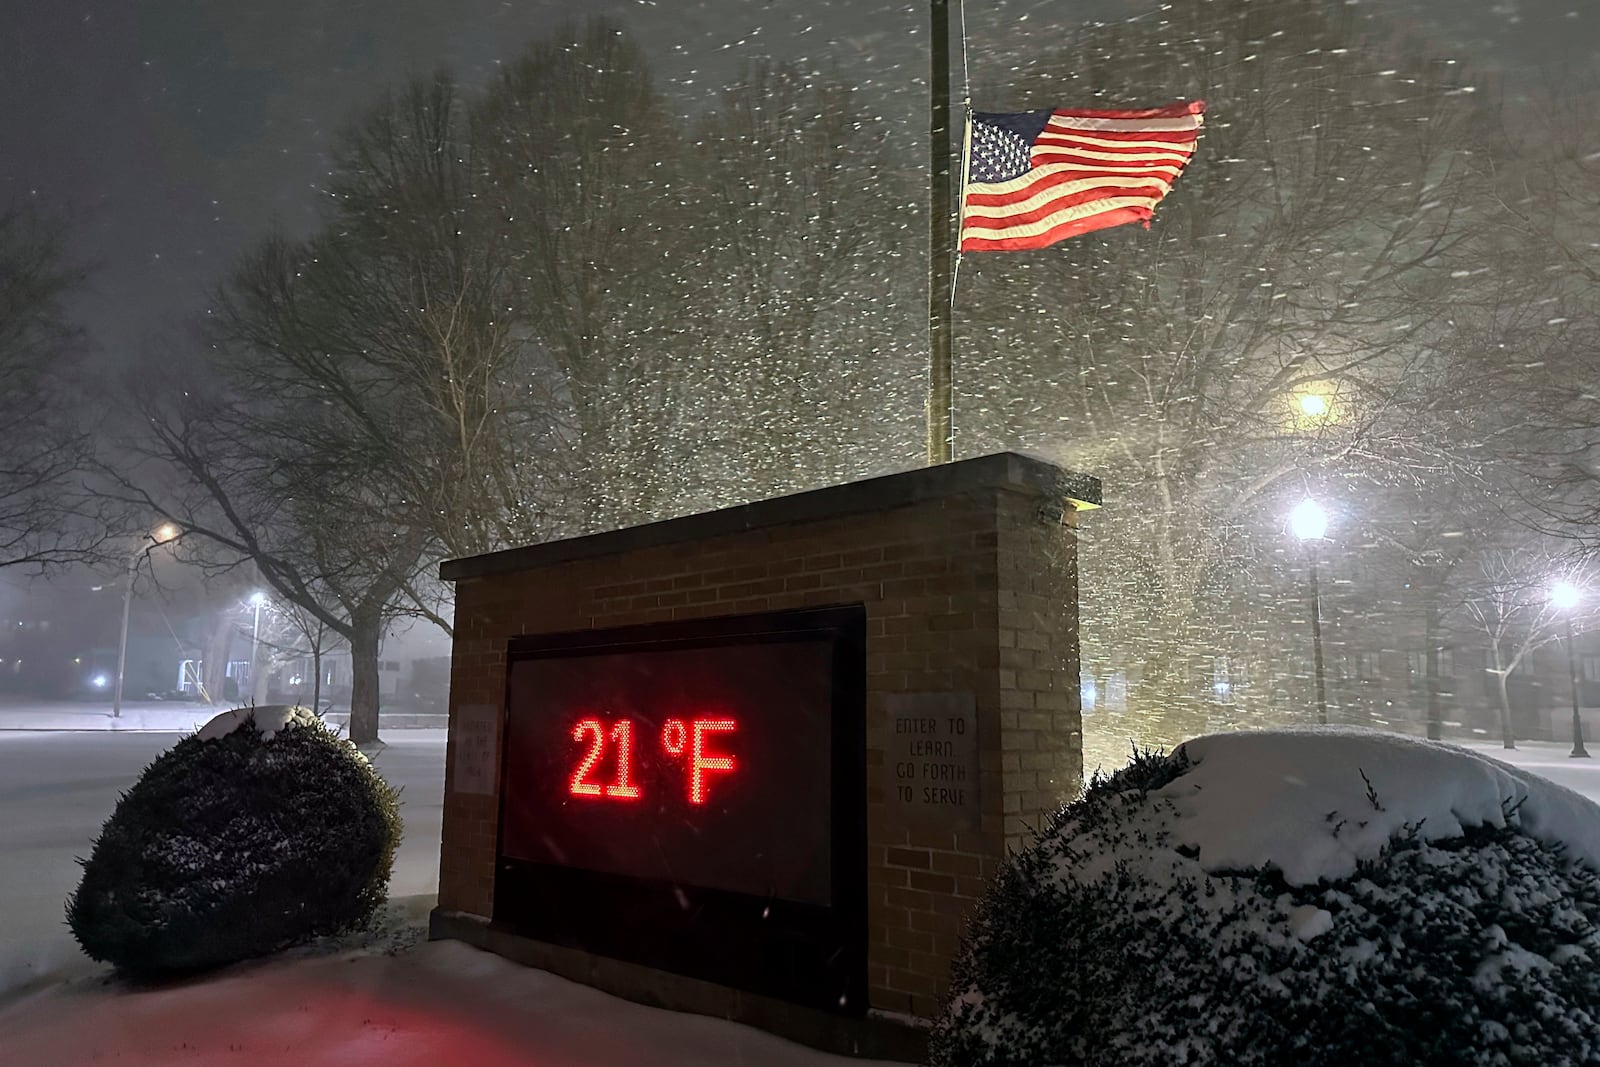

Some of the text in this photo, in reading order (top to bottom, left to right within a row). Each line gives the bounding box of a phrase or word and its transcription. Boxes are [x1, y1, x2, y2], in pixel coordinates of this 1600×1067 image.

[896, 718, 965, 735] ENTER TO
[909, 740, 953, 757] LEARN
[570, 719, 639, 798] 21
[896, 762, 966, 781] GO FORTH
[896, 785, 966, 806] TO SERVE
